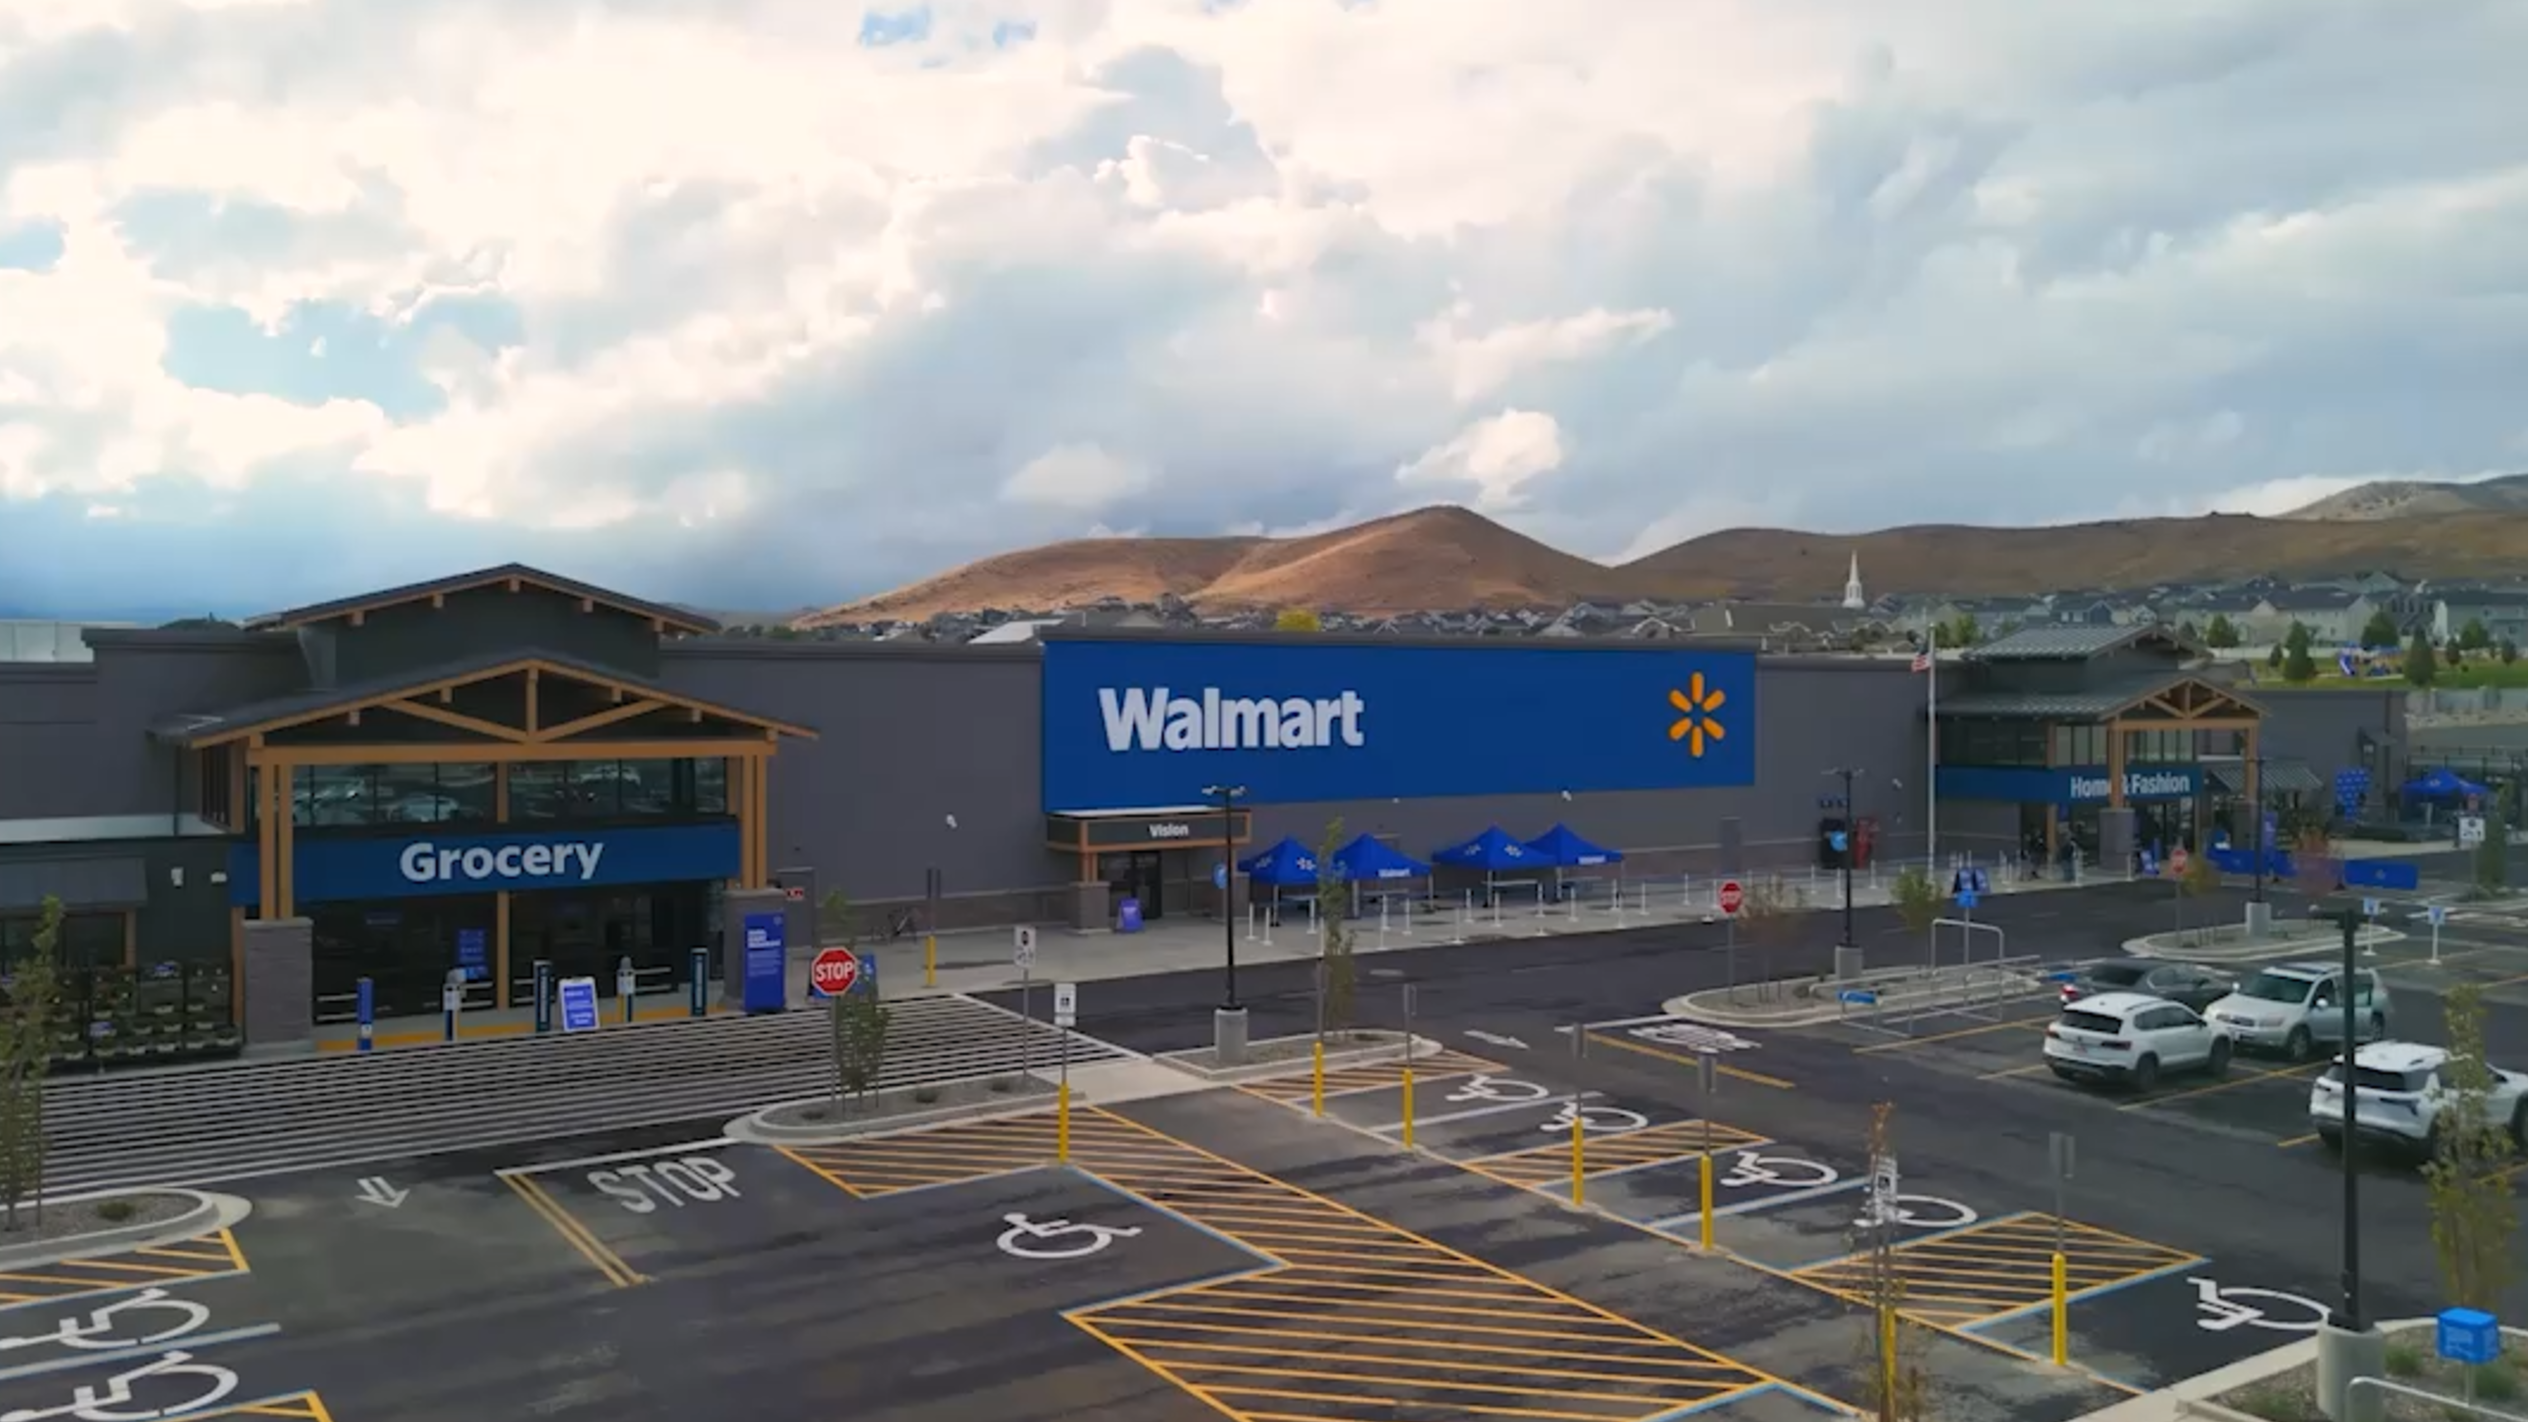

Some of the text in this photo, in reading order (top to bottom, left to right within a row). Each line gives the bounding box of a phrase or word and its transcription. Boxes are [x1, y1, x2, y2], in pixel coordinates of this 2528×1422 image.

[1098, 687, 1365, 751] Walmart
[2132, 771, 2190, 795] Fashion
[1149, 823, 1189, 838] Vision
[400, 842, 604, 882] Grocery
[815, 961, 855, 982] STOP
[586, 1156, 742, 1214] STOP
